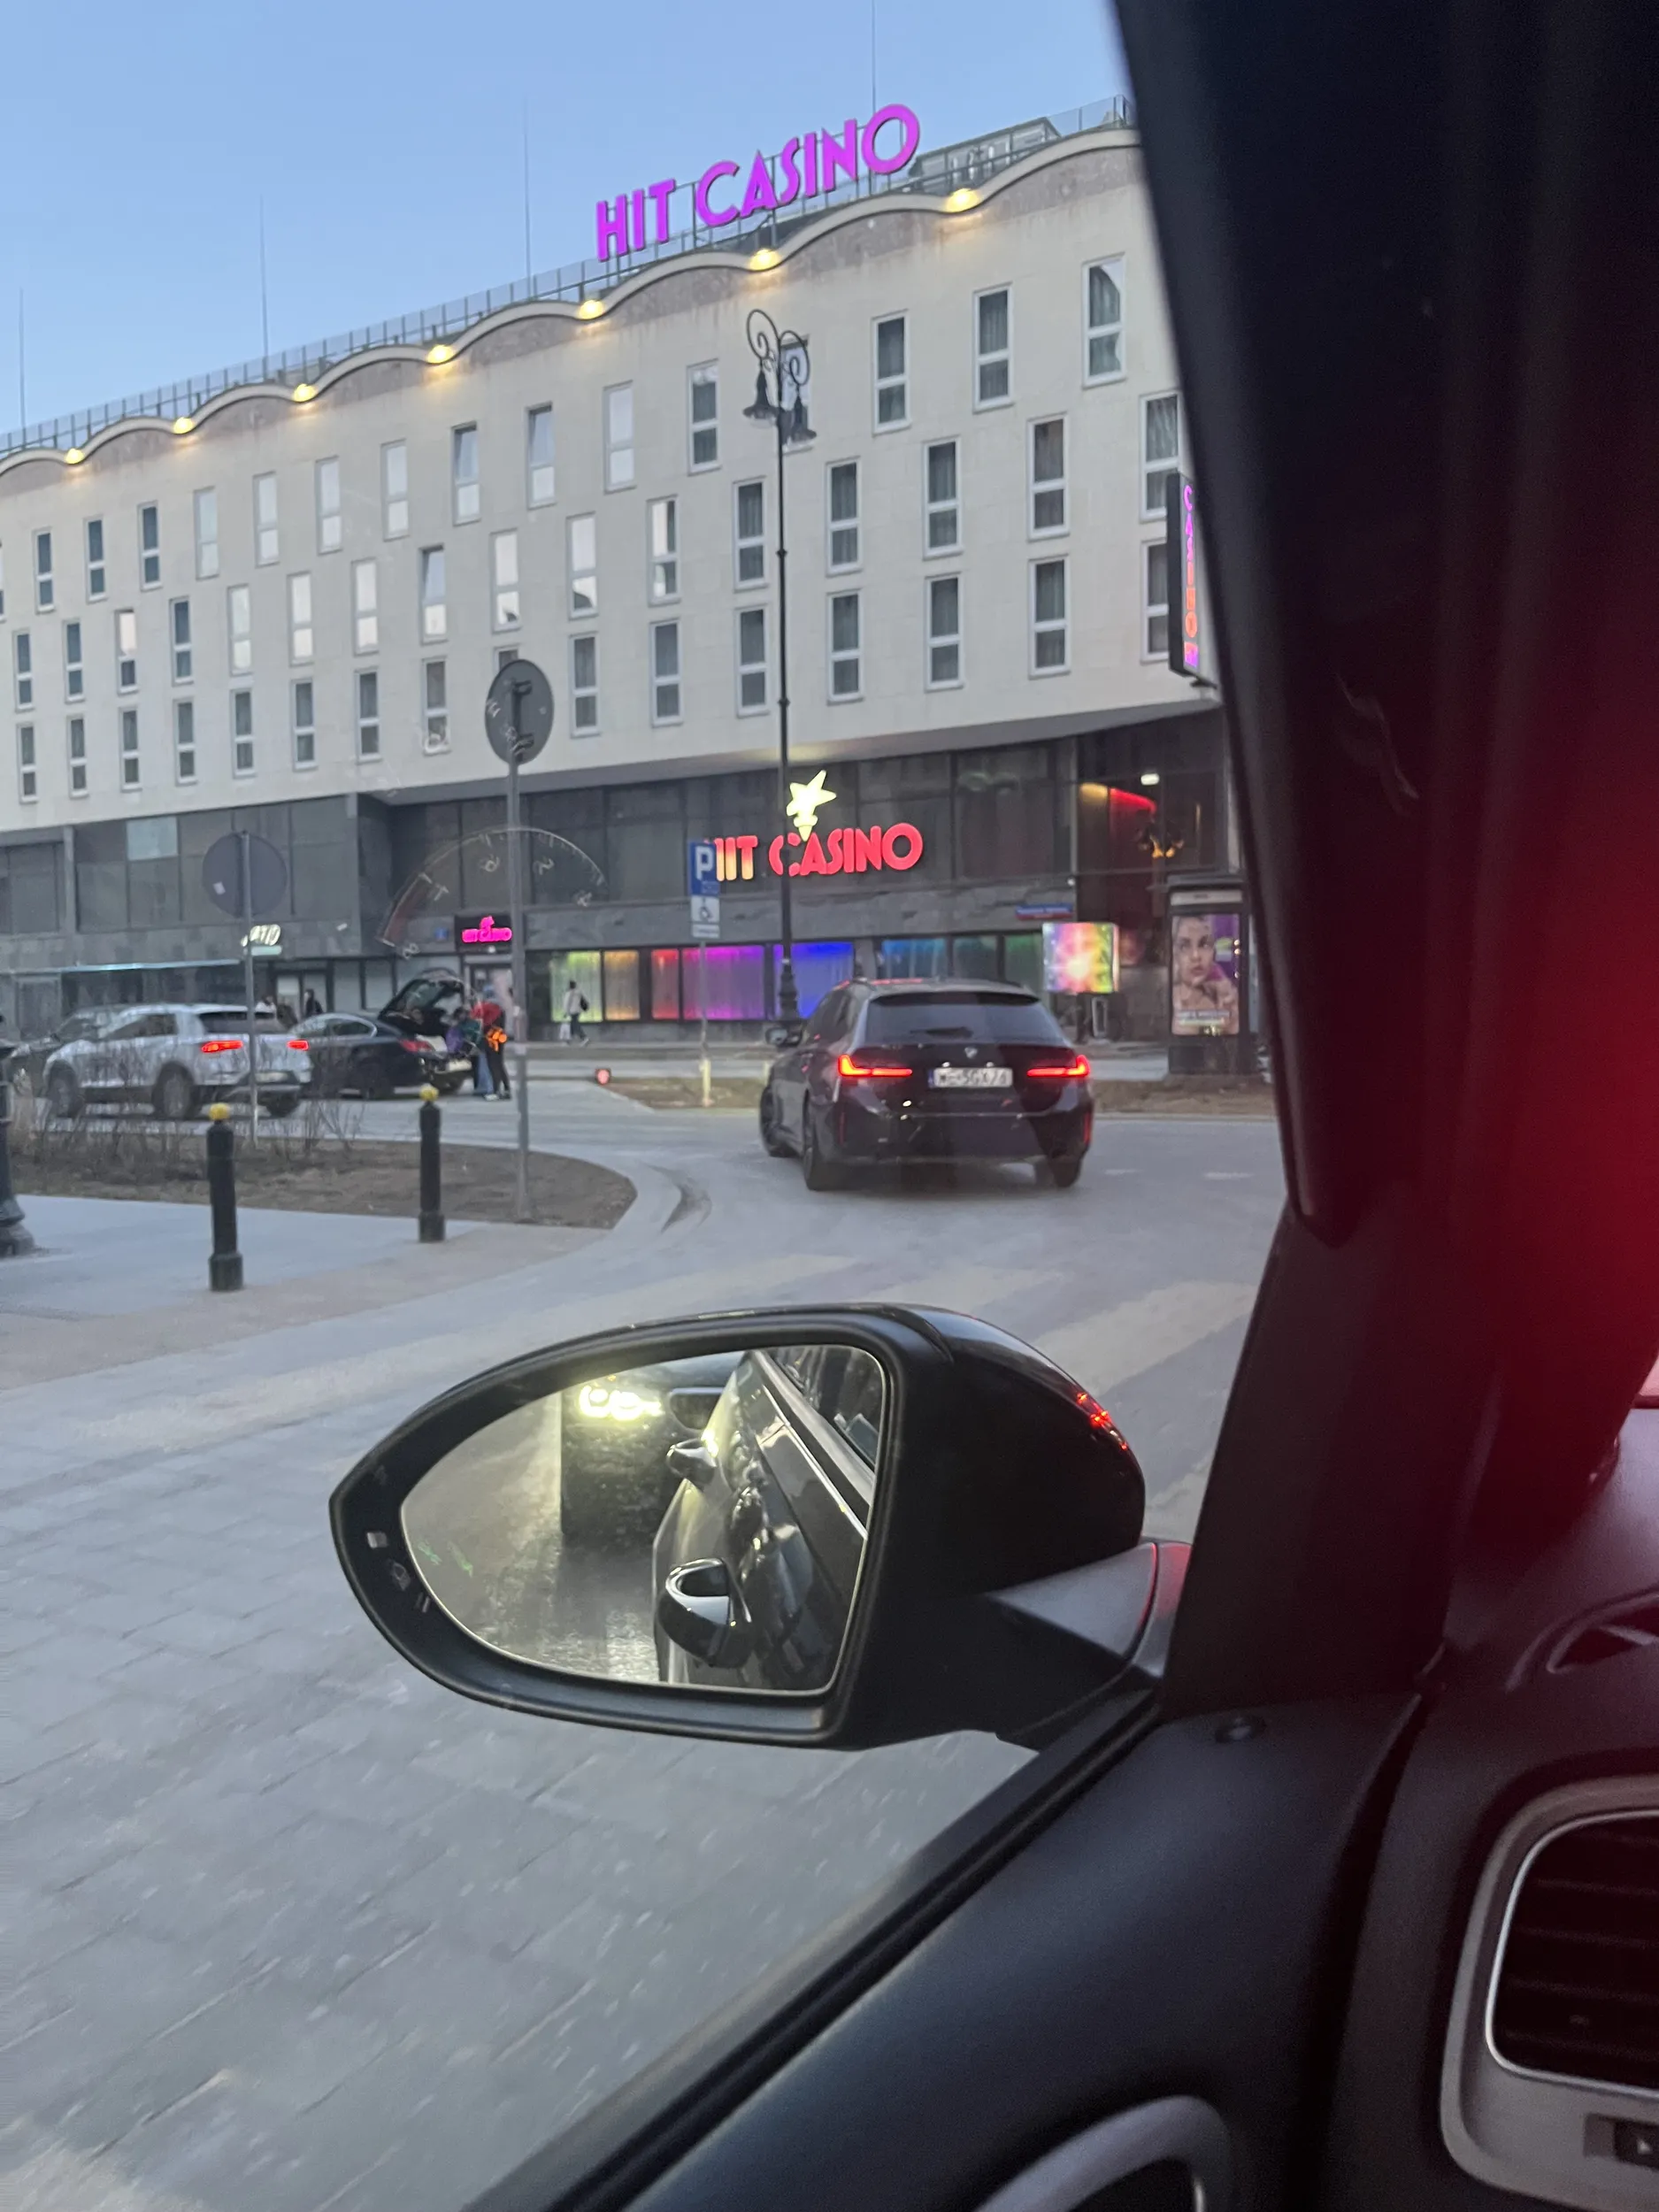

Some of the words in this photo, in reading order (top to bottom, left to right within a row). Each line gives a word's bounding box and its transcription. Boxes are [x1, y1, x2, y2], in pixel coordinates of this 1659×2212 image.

[595, 178, 676, 262] HIT
[695, 104, 920, 227] CASINO
[695, 846, 713, 880] P
[768, 822, 923, 877] CASINO
